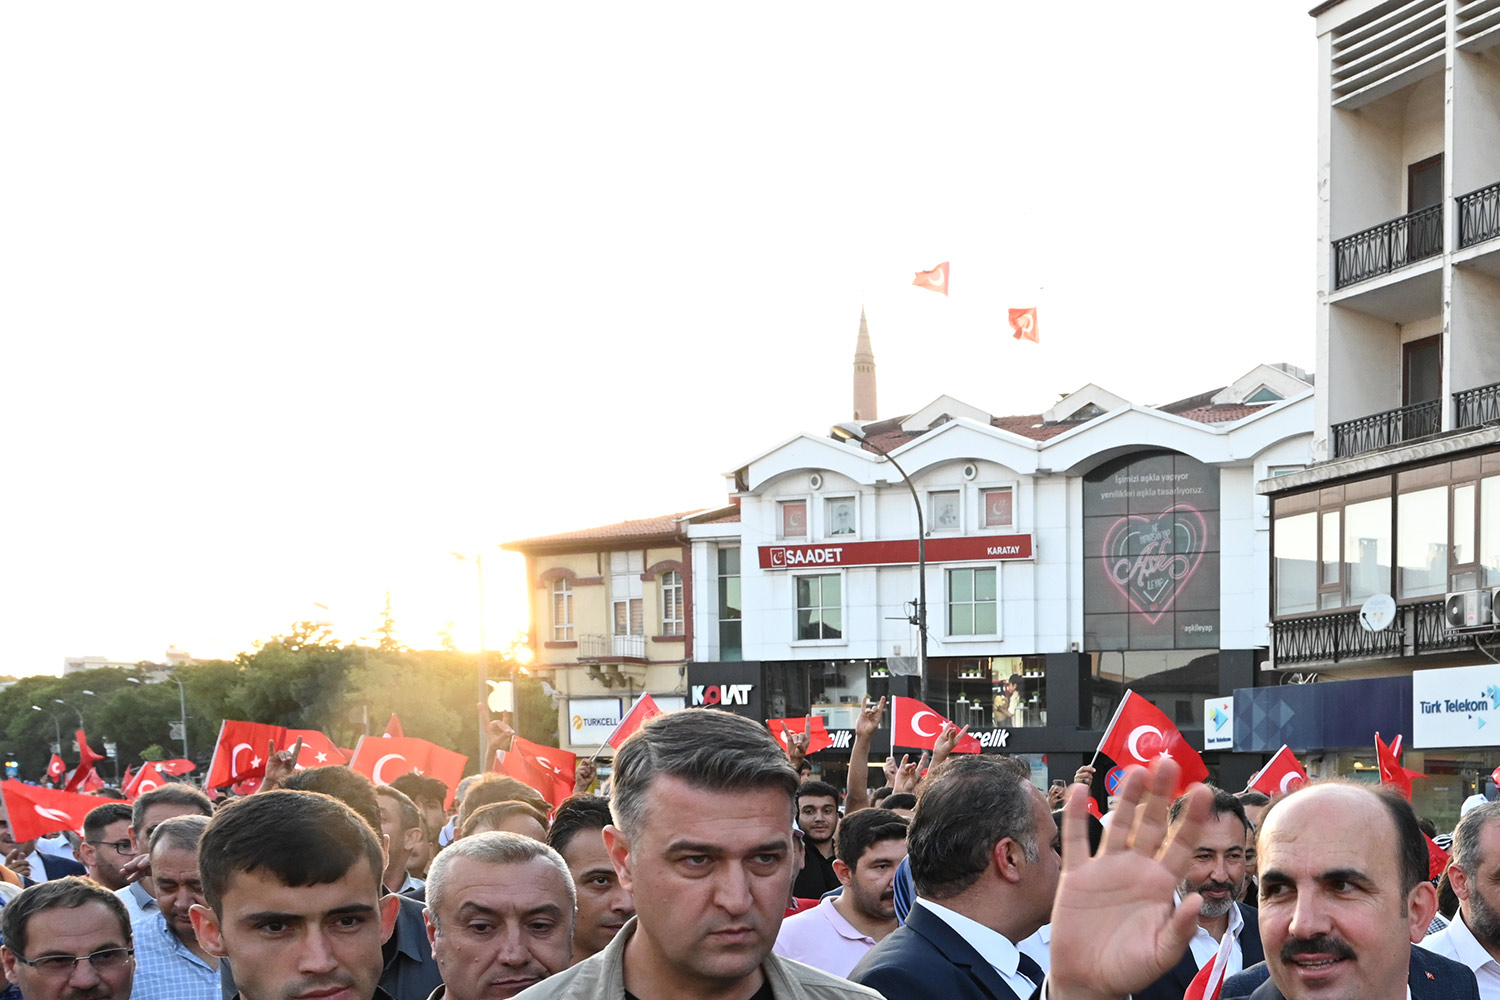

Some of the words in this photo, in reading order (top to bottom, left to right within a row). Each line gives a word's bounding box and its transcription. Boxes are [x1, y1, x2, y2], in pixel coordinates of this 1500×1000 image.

[1140, 473, 1160, 483] aşkla
[1161, 473, 1189, 482] yapıyor
[1136, 488, 1156, 498] aşkla
[987, 545, 1020, 555] KARATAY
[785, 548, 843, 565] SAADET
[691, 684, 755, 705] KOLAT
[1420, 701, 1442, 714] Türk
[1444, 699, 1488, 713] Telekom
[583, 717, 618, 727] TURKCELL
